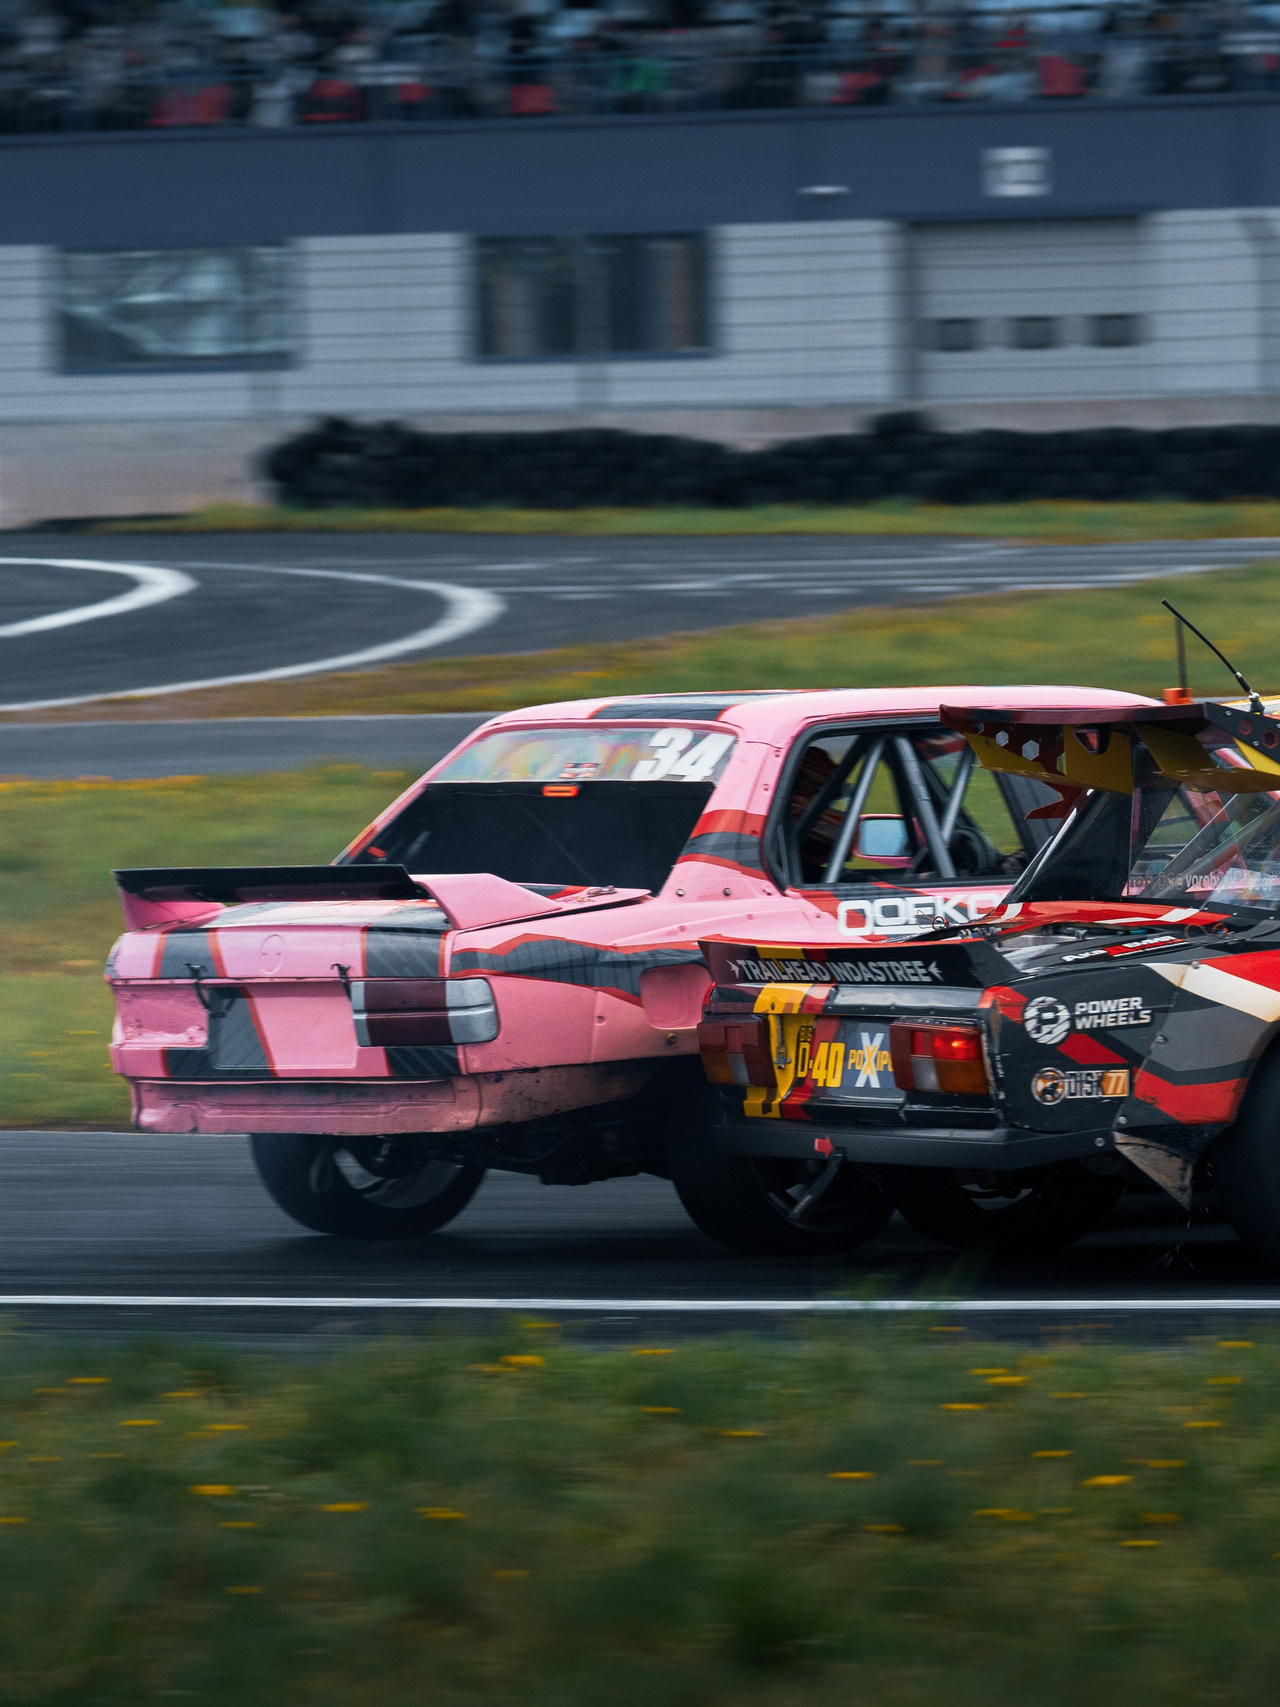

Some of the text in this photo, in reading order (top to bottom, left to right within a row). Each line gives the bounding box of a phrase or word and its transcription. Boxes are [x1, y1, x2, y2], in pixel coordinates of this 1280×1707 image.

[630, 728, 737, 781] 34
[736, 959, 932, 982] TRAILHEAD INDASTREE
[1074, 997, 1143, 1015] POWER
[1074, 1010, 1152, 1030] WHEELS
[797, 1042, 845, 1088] D-40
[847, 1033, 893, 1088] POXIP
